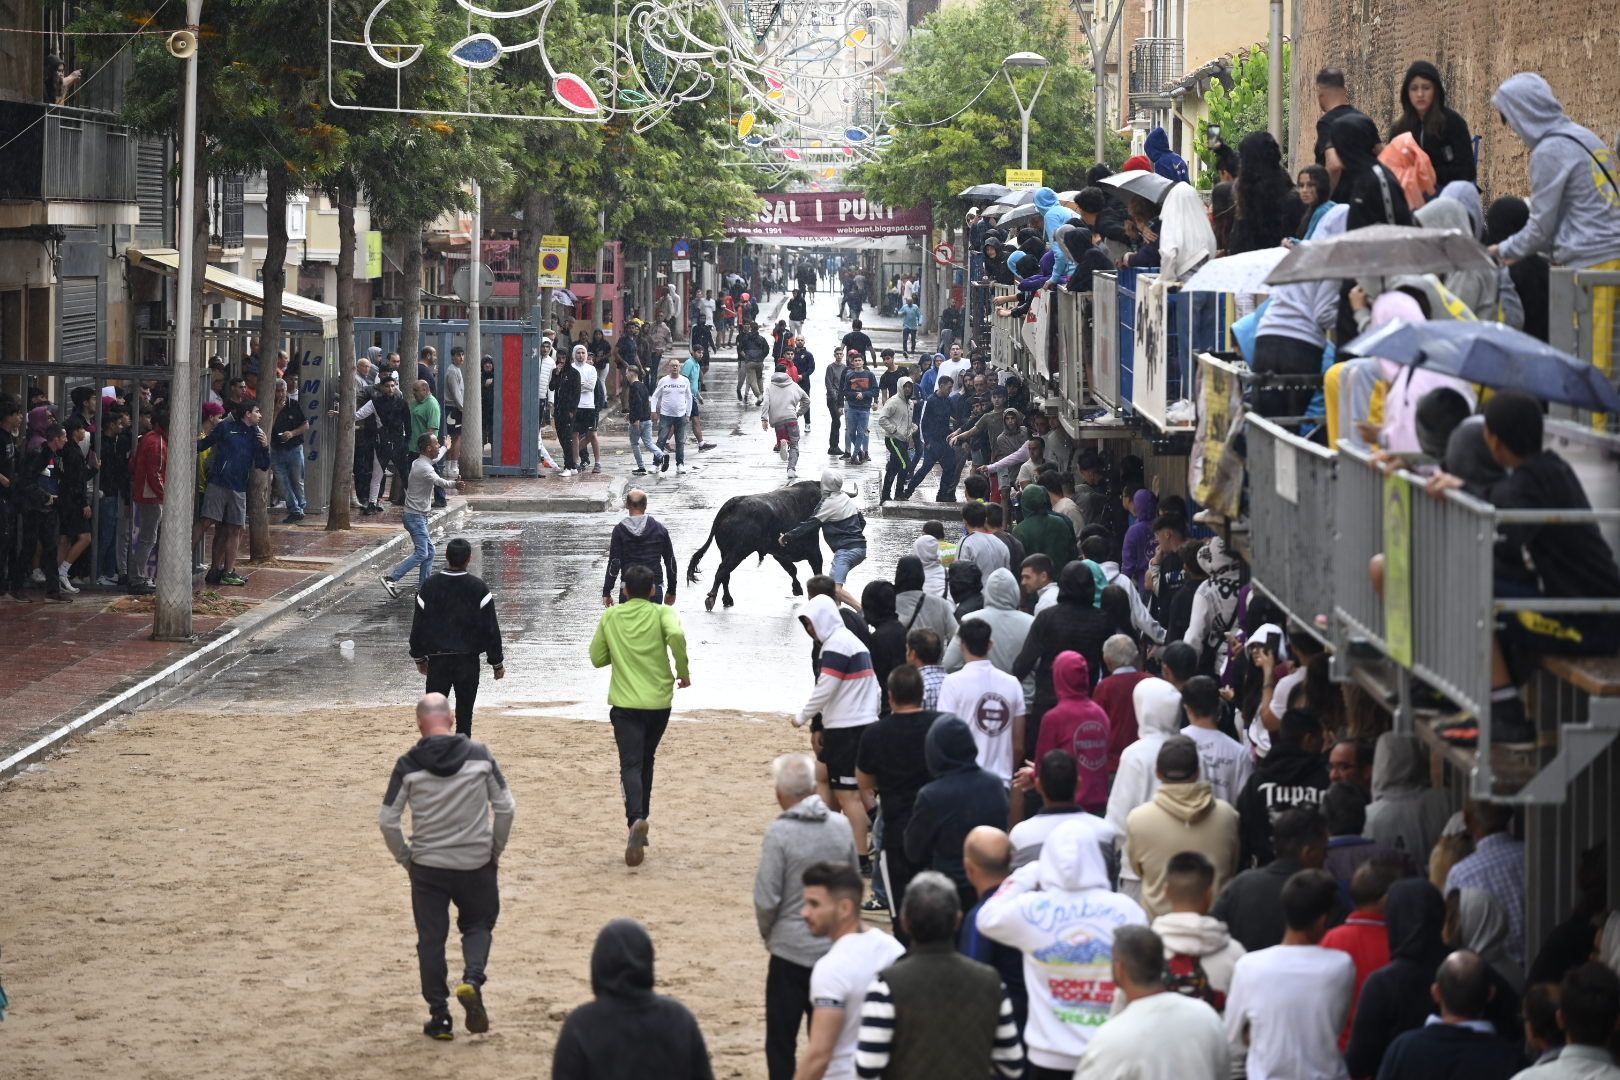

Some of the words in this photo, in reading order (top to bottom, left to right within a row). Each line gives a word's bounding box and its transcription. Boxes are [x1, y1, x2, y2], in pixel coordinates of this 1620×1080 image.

[815, 199, 823, 222] I
[836, 225, 927, 234] webipunt.blogspot.com
[301, 350, 323, 366] La
[302, 379, 321, 461] Merla
